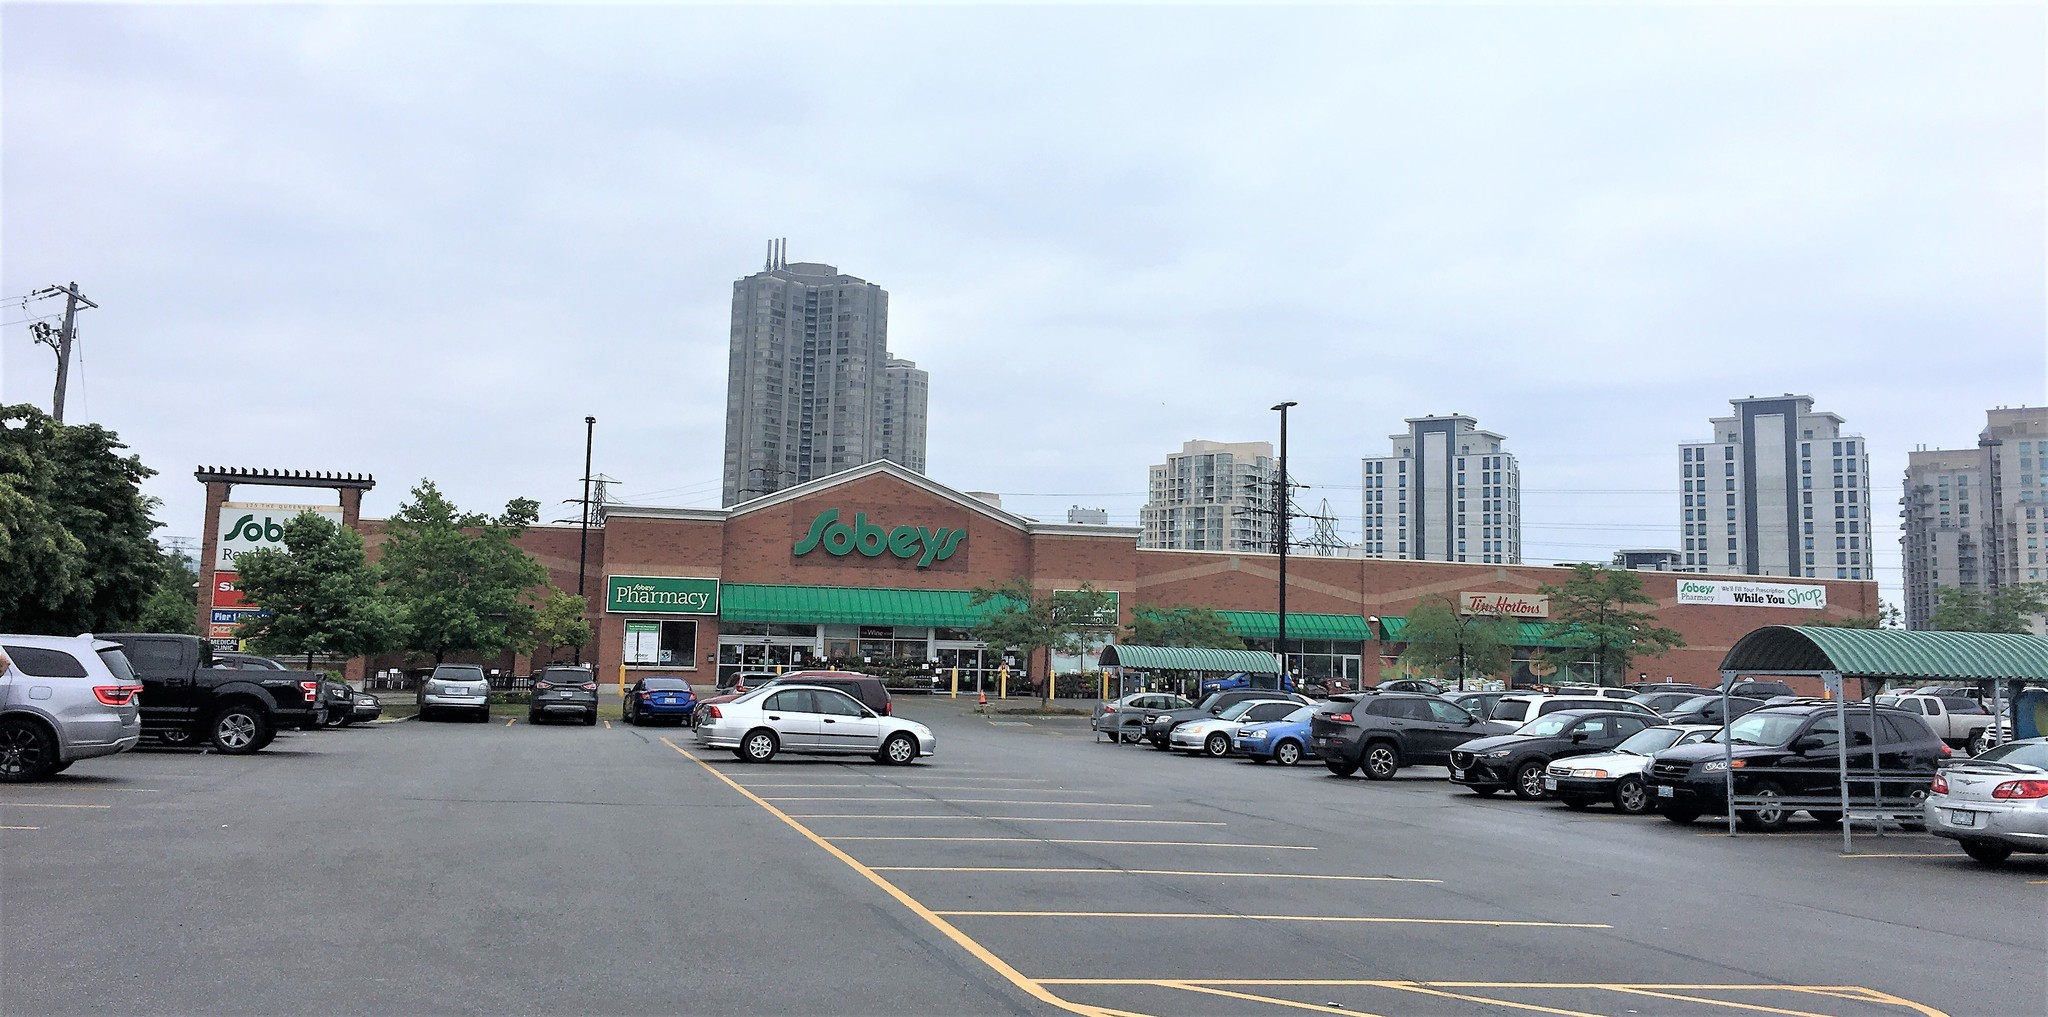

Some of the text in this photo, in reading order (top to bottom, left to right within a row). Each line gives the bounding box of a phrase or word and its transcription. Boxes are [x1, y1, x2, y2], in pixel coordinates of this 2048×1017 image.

[224, 514, 284, 542] Sob
[794, 507, 967, 567] Sobeys
[633, 583, 656, 591] Sobeys
[1681, 581, 1715, 594] Sobeys
[616, 585, 710, 610] Pharmacy
[1469, 596, 1540, 614] Tim Hortons
[1681, 593, 1715, 602] Pharmacy
[1733, 588, 1822, 606] While You Shop
[214, 613, 231, 621] Pier
